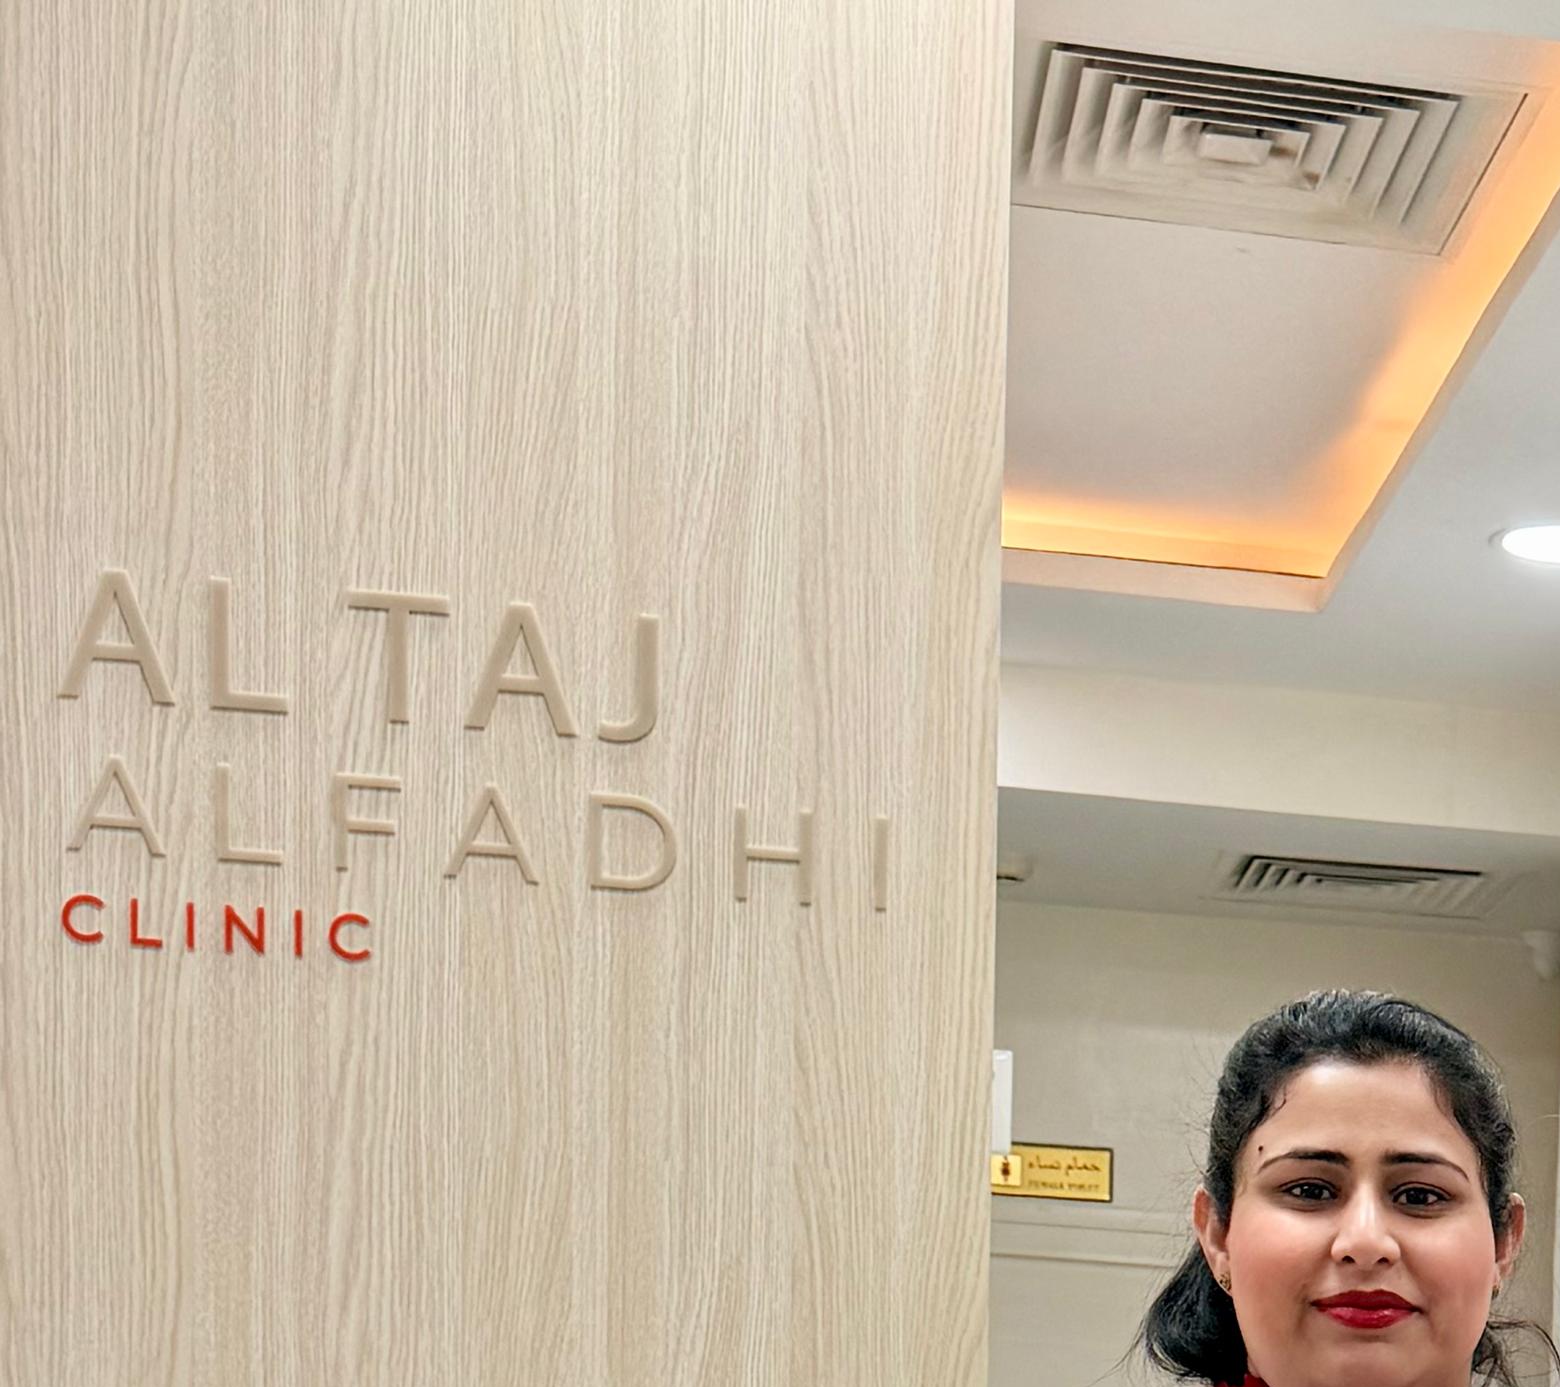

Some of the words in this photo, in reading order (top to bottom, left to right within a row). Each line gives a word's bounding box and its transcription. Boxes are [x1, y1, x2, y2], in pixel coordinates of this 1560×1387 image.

[56, 567, 289, 715] AL
[346, 586, 661, 744] TAJ
[61, 894, 371, 962] CLINIC
